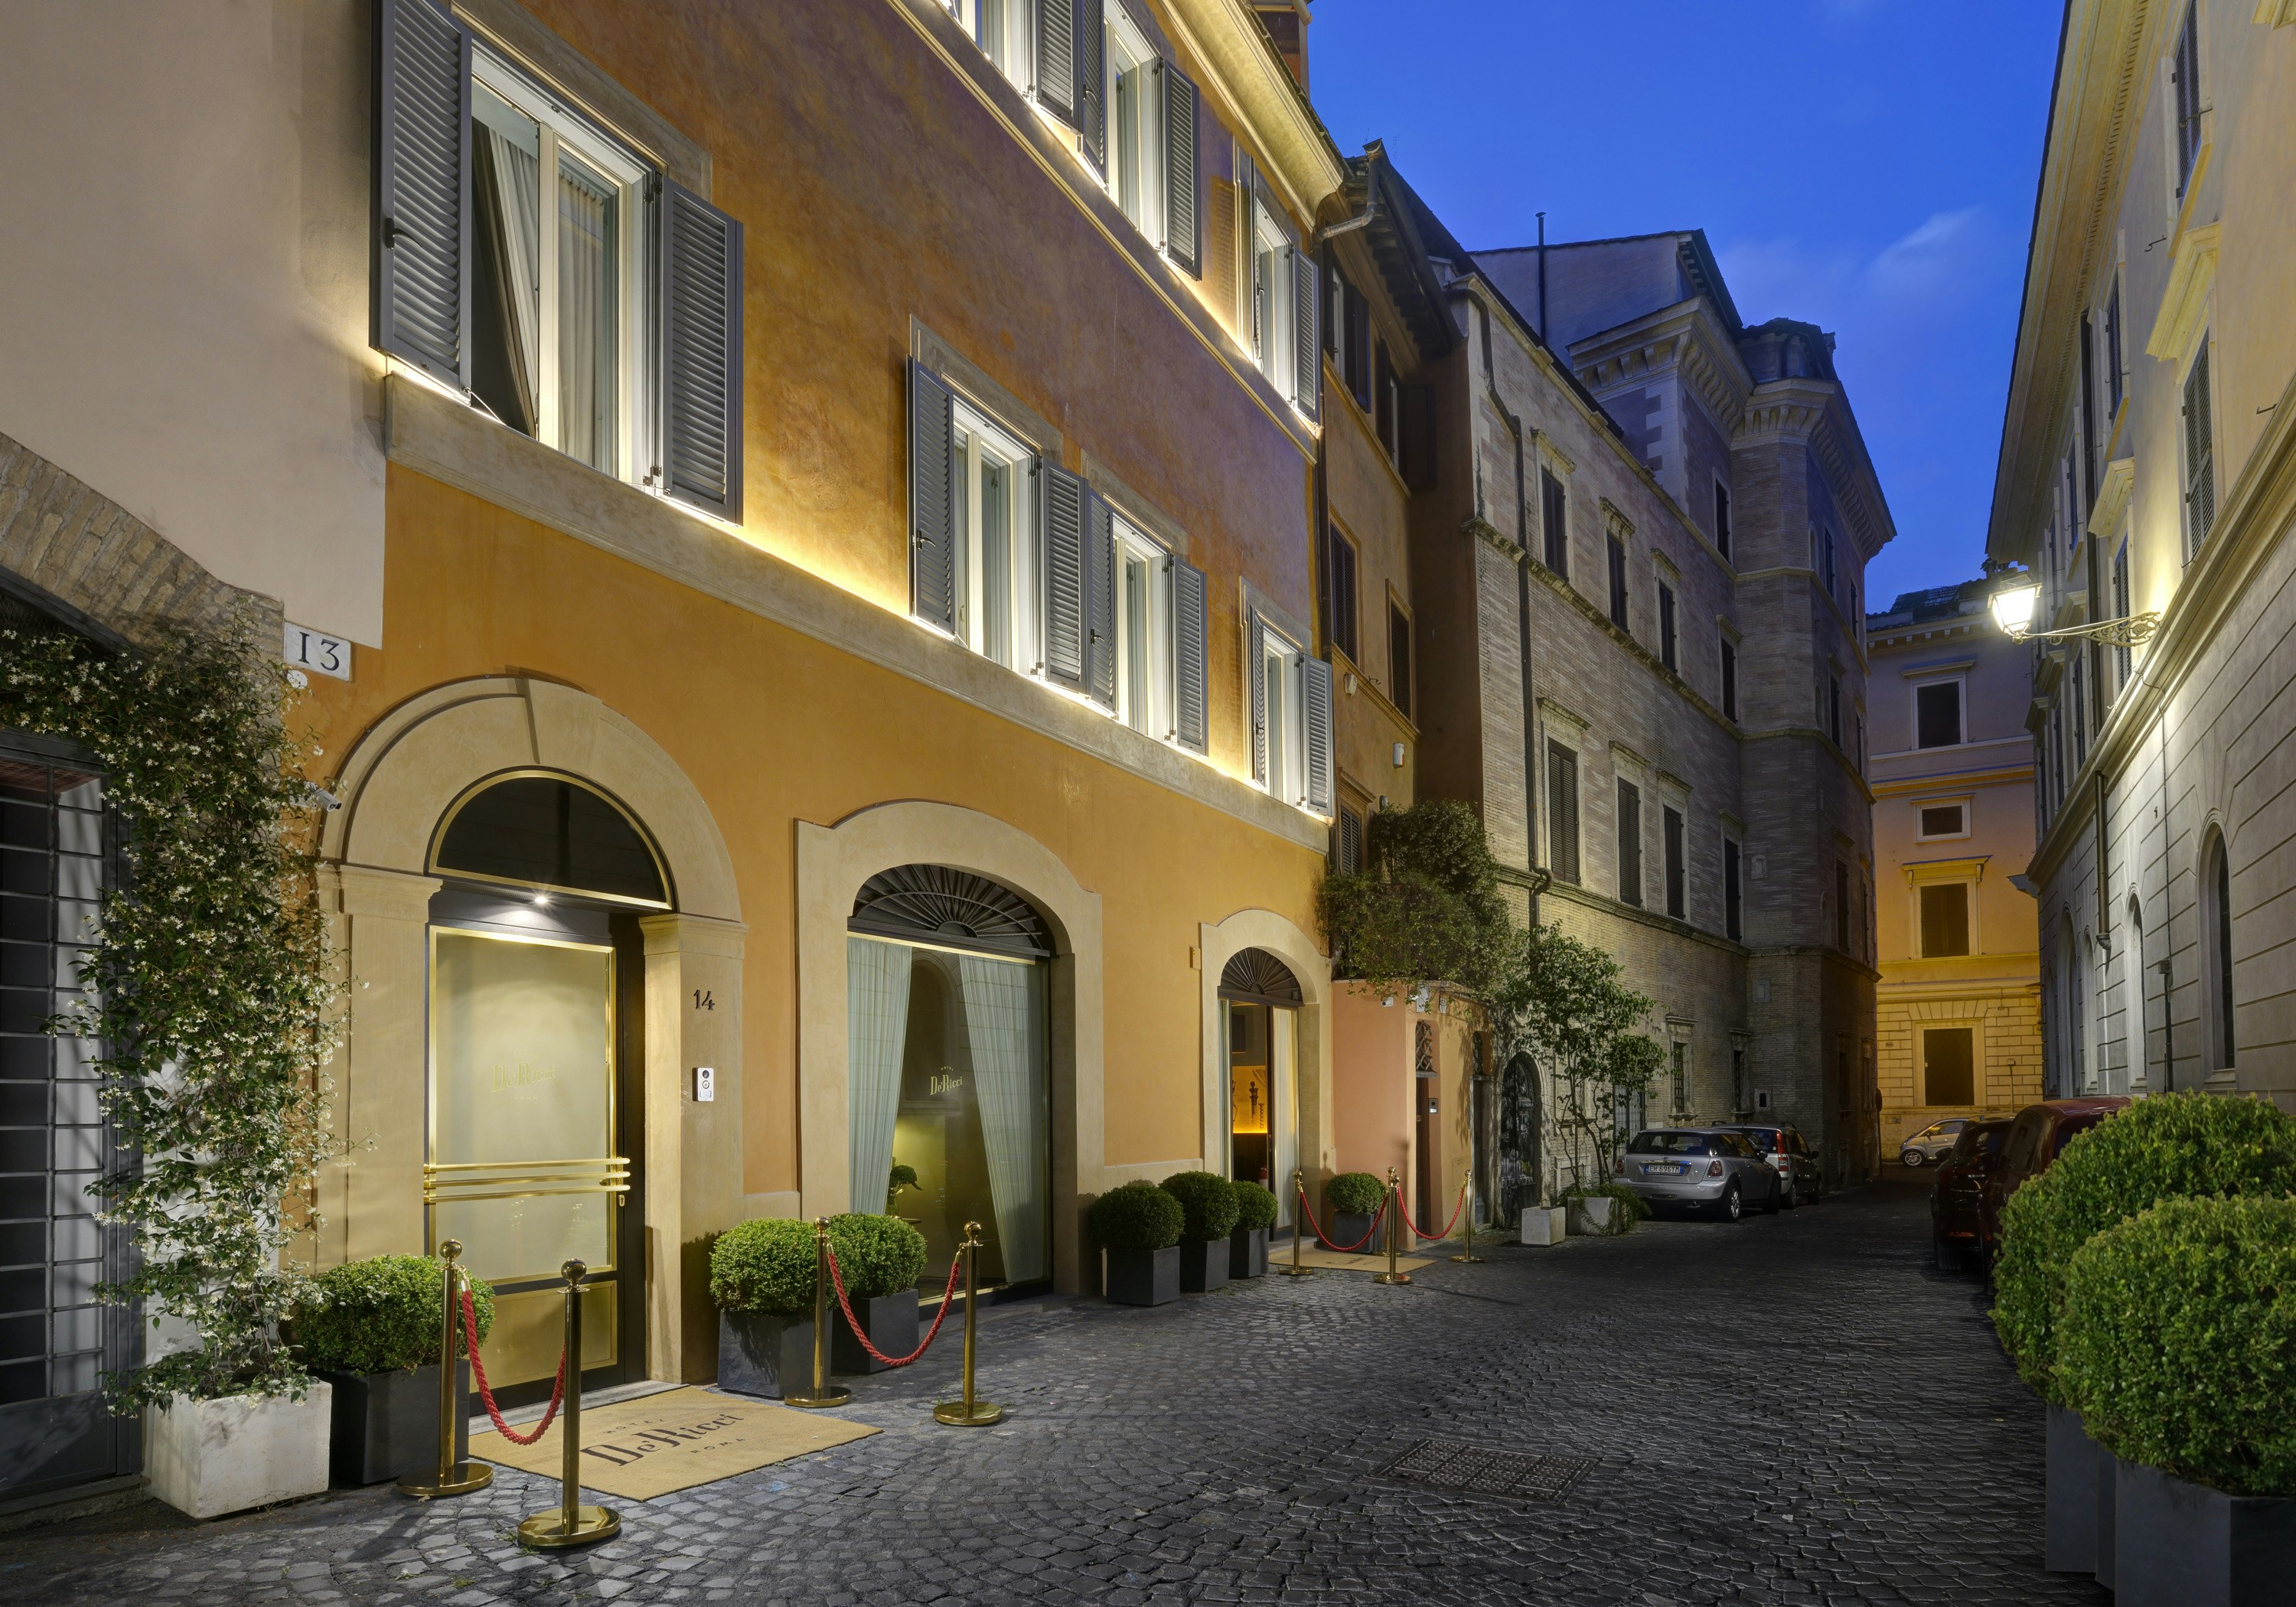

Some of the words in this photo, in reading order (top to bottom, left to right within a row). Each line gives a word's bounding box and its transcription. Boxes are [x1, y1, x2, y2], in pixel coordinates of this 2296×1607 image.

[298, 631, 340, 671] 13
[693, 989, 715, 1011] 14
[690, 1439, 747, 1454] ROMA
